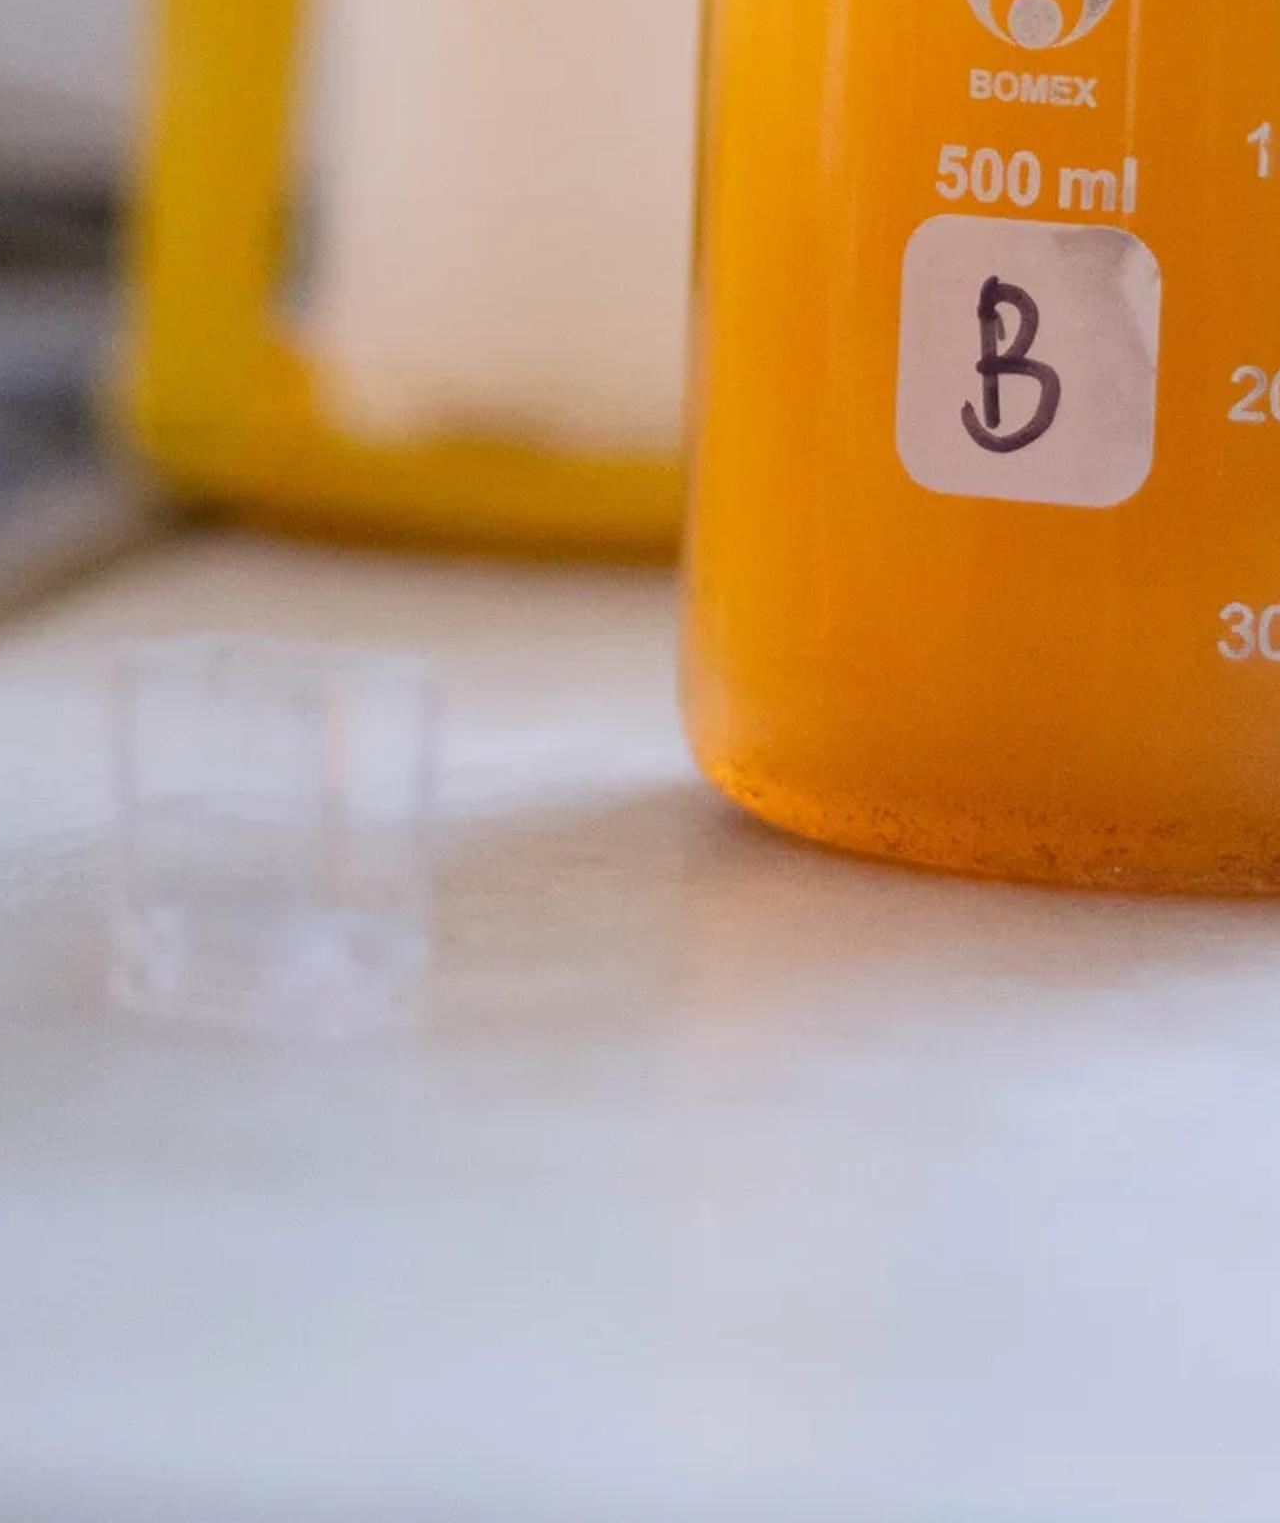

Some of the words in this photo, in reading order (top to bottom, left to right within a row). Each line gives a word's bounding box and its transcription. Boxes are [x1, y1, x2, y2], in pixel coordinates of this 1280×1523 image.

[969, 68, 1098, 108] BOMEX
[935, 144, 1041, 207] 500
[1058, 156, 1138, 213] ml
[960, 275, 1061, 453] B
